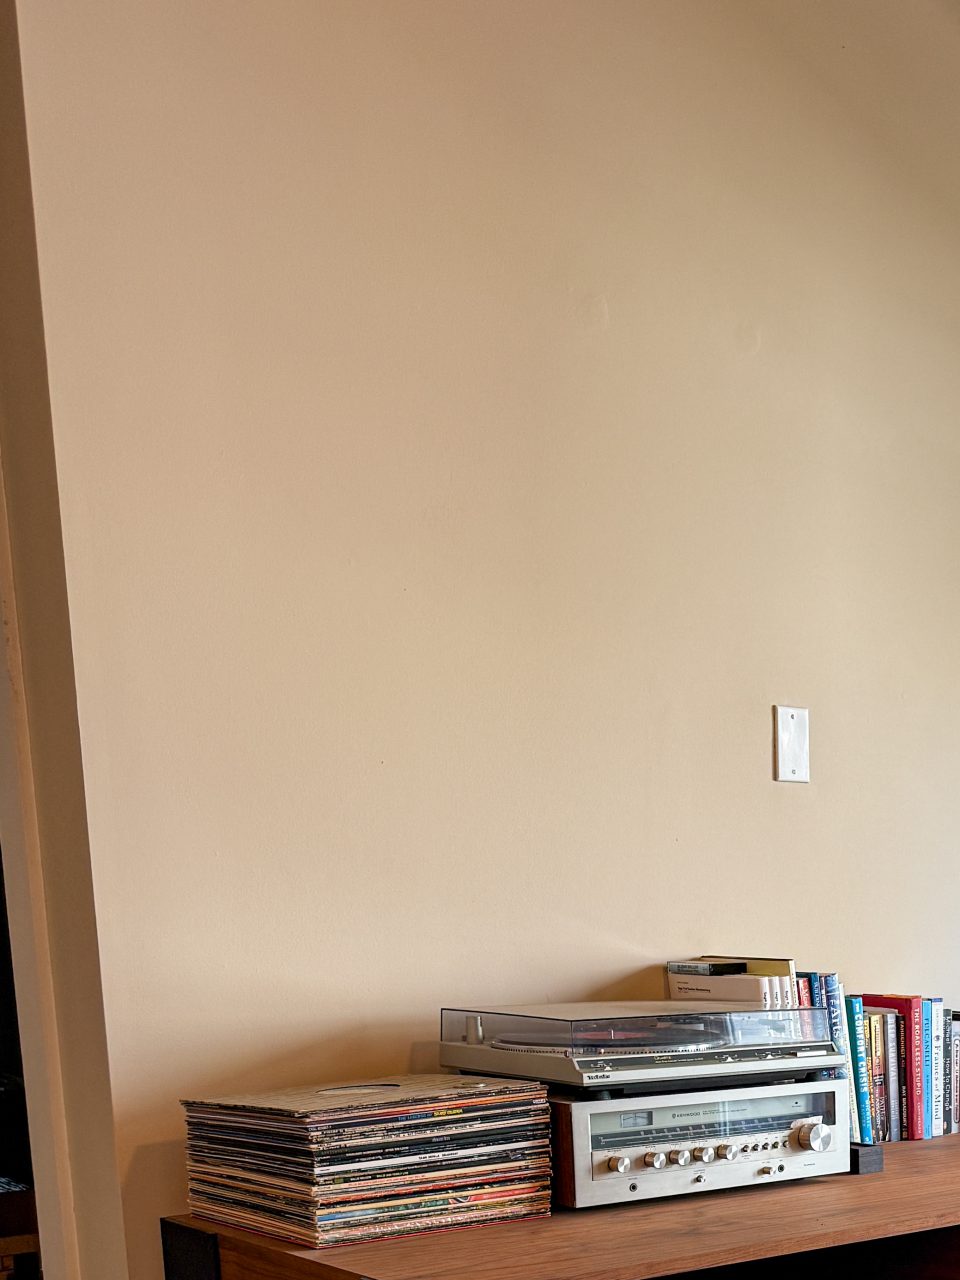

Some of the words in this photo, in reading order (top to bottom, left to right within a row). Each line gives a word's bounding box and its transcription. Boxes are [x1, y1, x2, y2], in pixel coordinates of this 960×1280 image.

[830, 1006, 842, 1039] Arts
[855, 1013, 866, 1058] COMFORT
[858, 1061, 868, 1093] CRISIS
[888, 1042, 898, 1081] SURVIVAL
[945, 1074, 951, 1083] to
